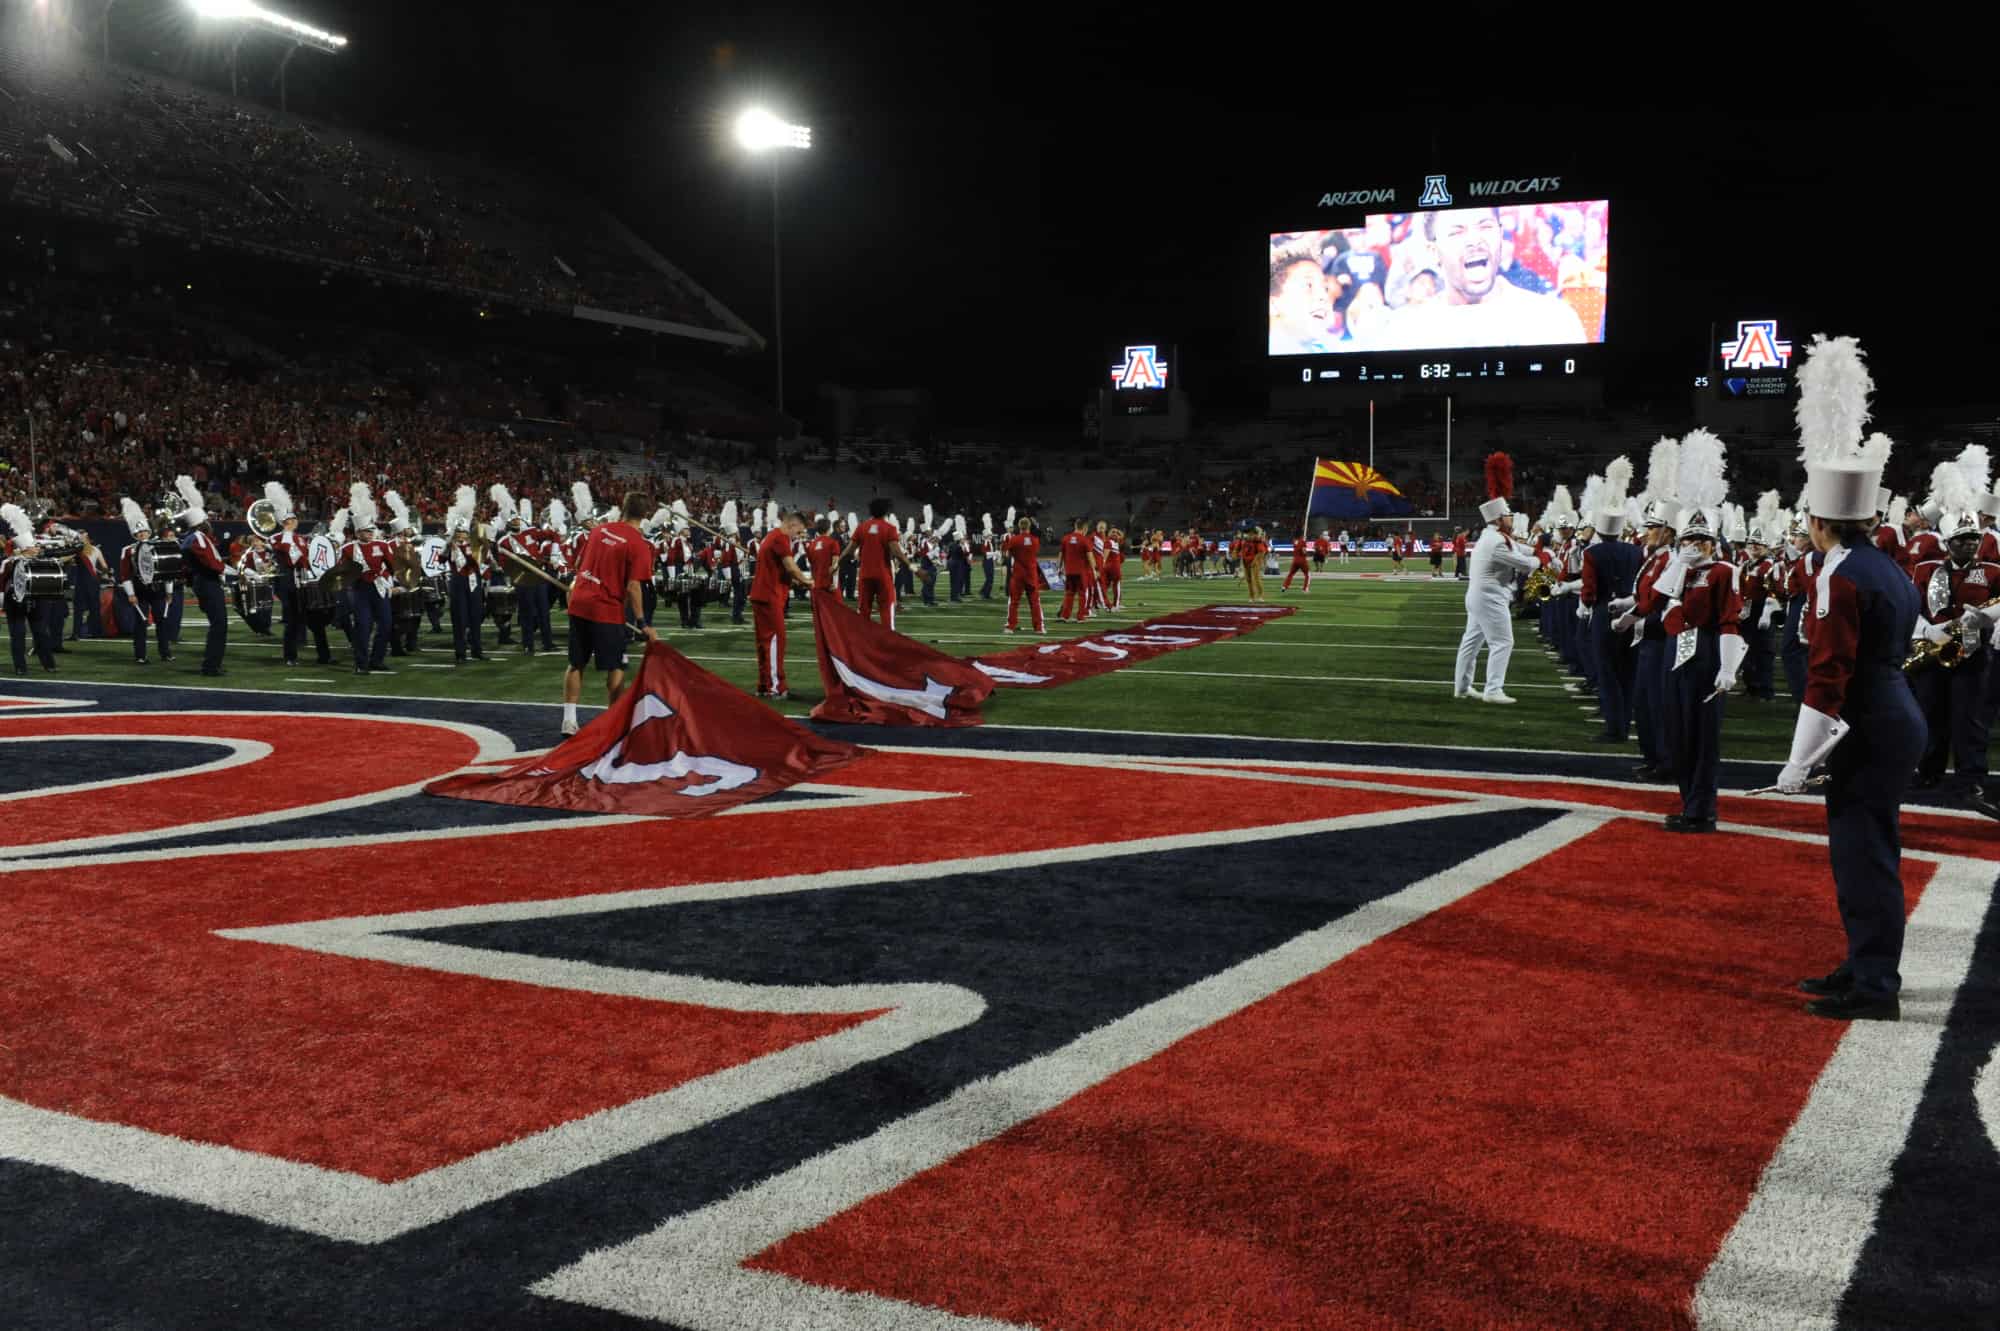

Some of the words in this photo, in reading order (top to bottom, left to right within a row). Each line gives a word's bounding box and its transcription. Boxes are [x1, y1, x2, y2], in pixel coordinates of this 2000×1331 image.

[1418, 175, 1452, 206] A
[1469, 177, 1560, 196] WILDCATS
[1317, 188, 1395, 207] ARIZONA
[1722, 320, 1790, 369] A
[1112, 345, 1167, 390] A
[1302, 368, 1312, 382] 0
[1420, 363, 1450, 378] 6:32
[1564, 359, 1575, 374] 0
[1694, 377, 1708, 386] 25
[312, 543, 329, 571] A
